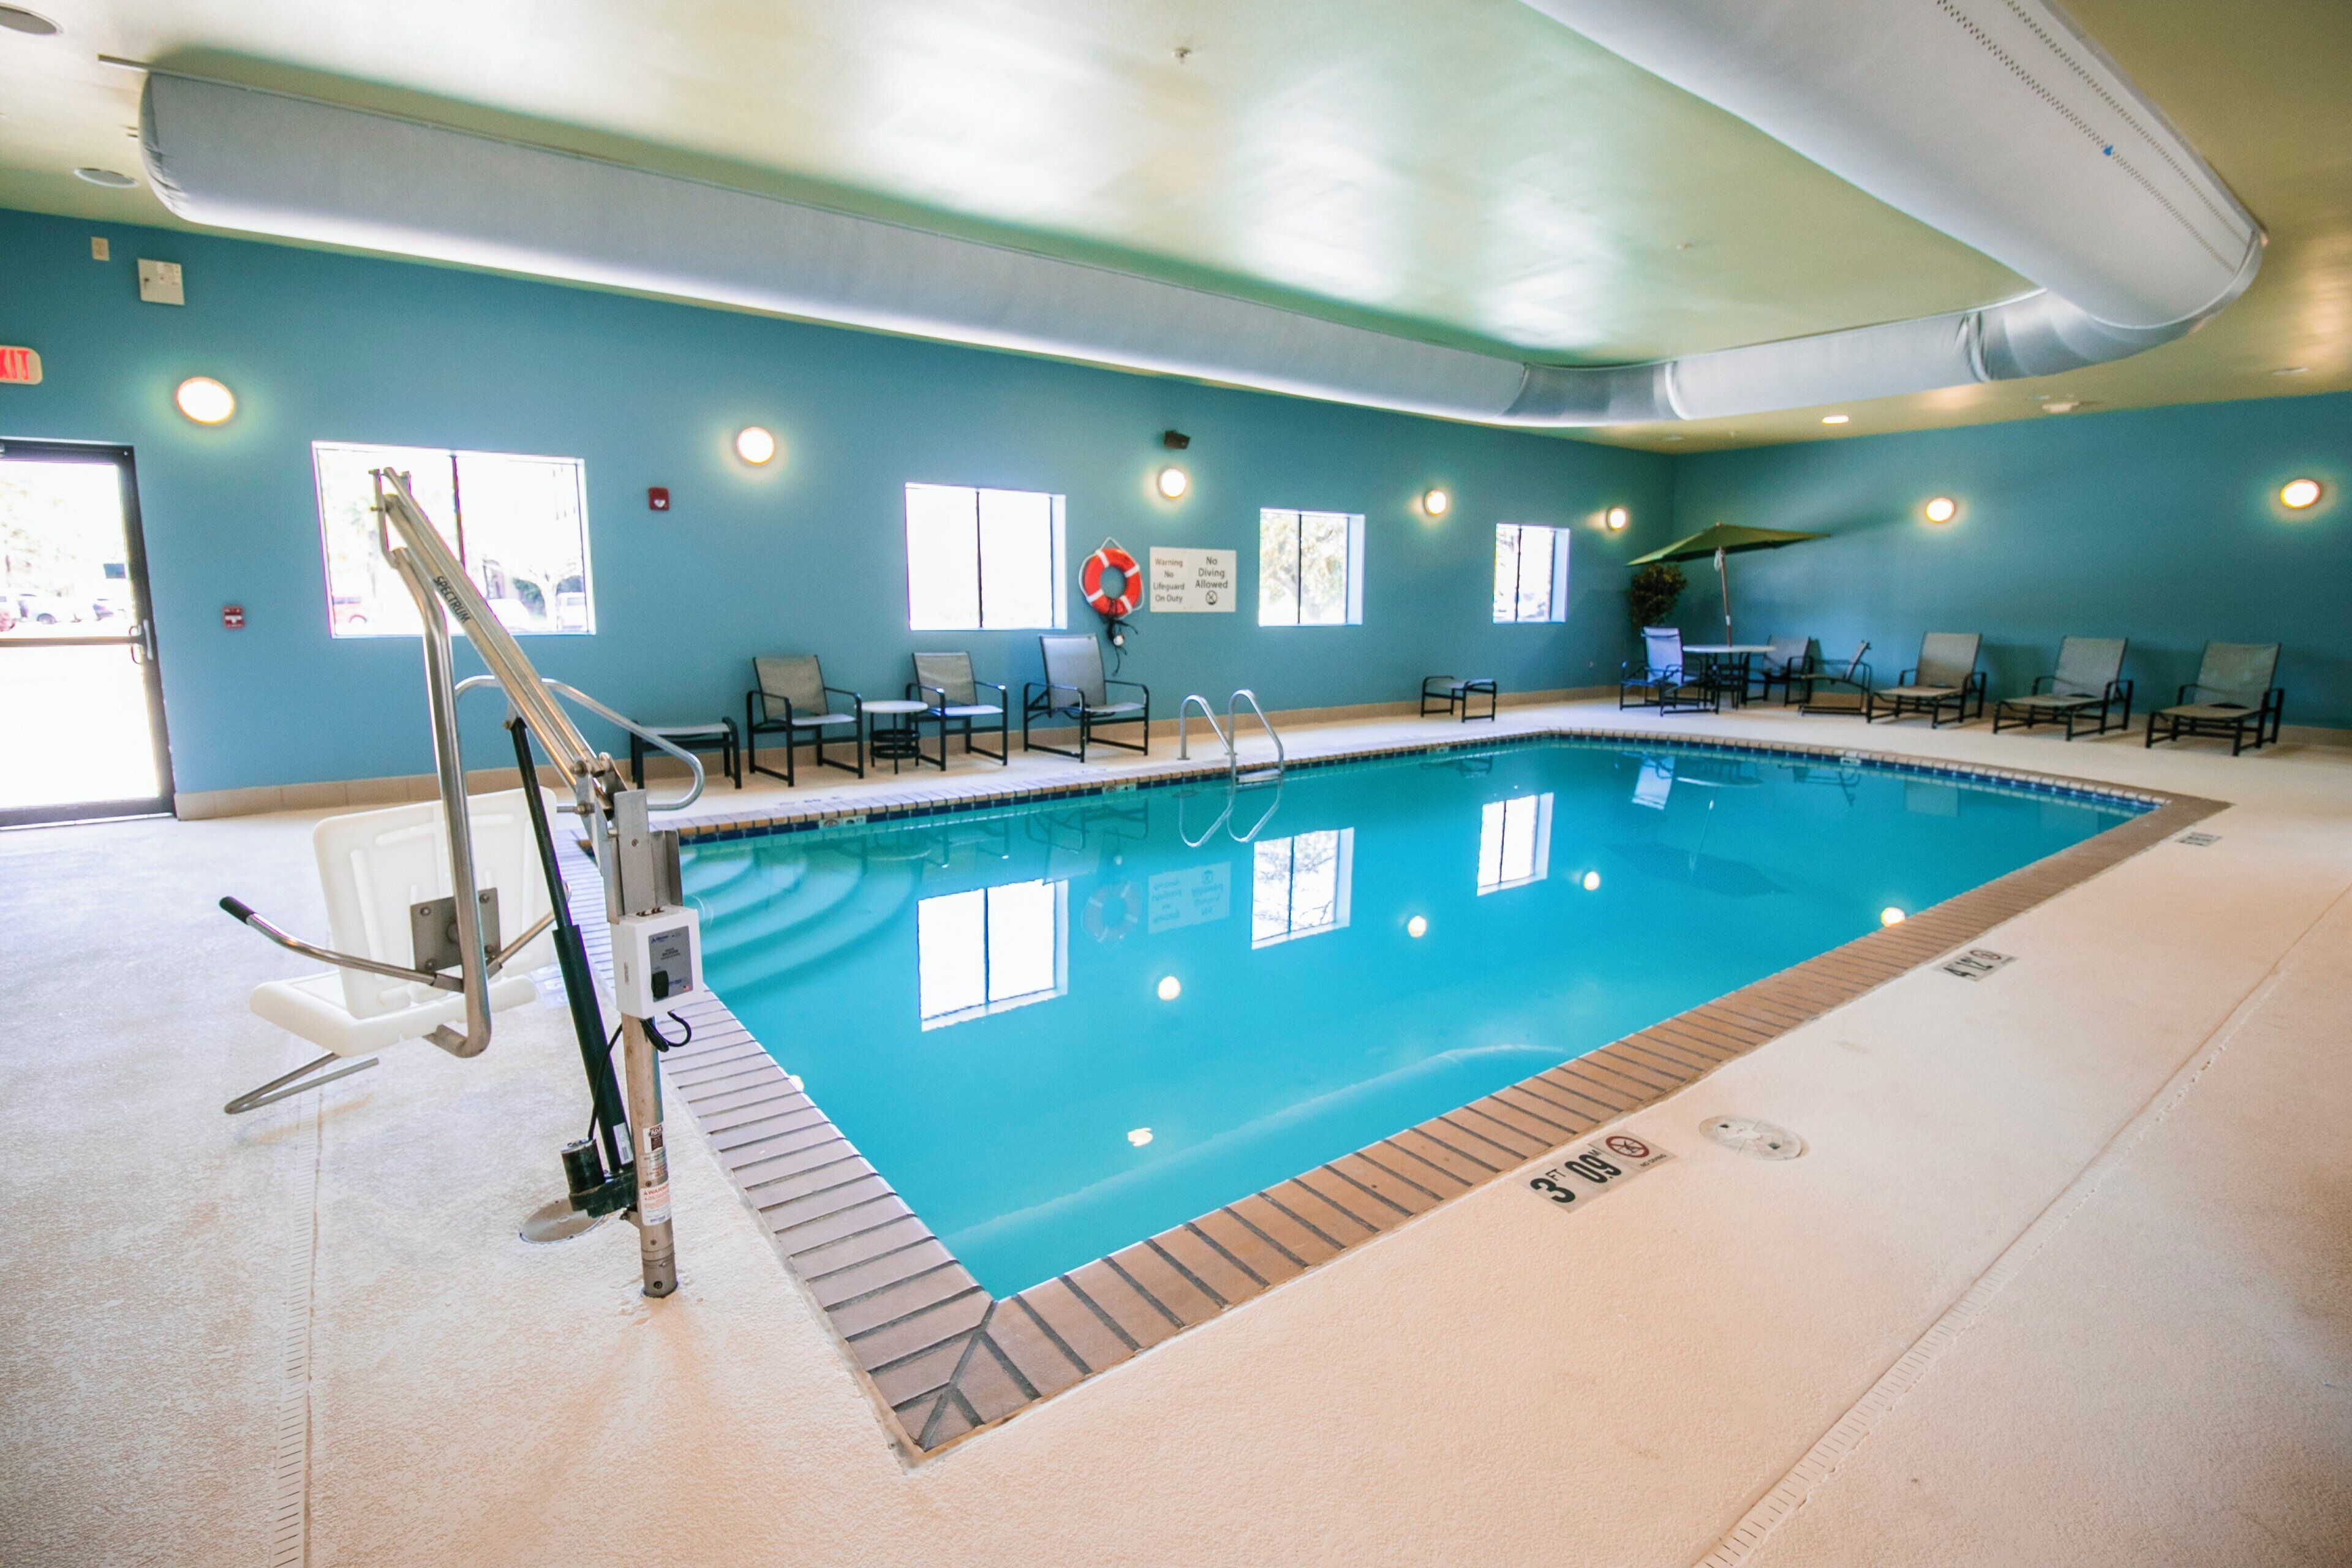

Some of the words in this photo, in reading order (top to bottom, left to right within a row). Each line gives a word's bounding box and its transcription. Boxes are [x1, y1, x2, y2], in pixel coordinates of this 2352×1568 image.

[1155, 558, 1183, 568] Warning
[1206, 556, 1218, 565] No
[1198, 568, 1225, 579] Diving
[1153, 583, 1185, 592] Lifeguard
[1195, 580, 1228, 589] Allowed
[432, 576, 471, 624] SPECTRUM
[1155, 594, 1165, 603] On
[1167, 595, 1183, 603] Duty
